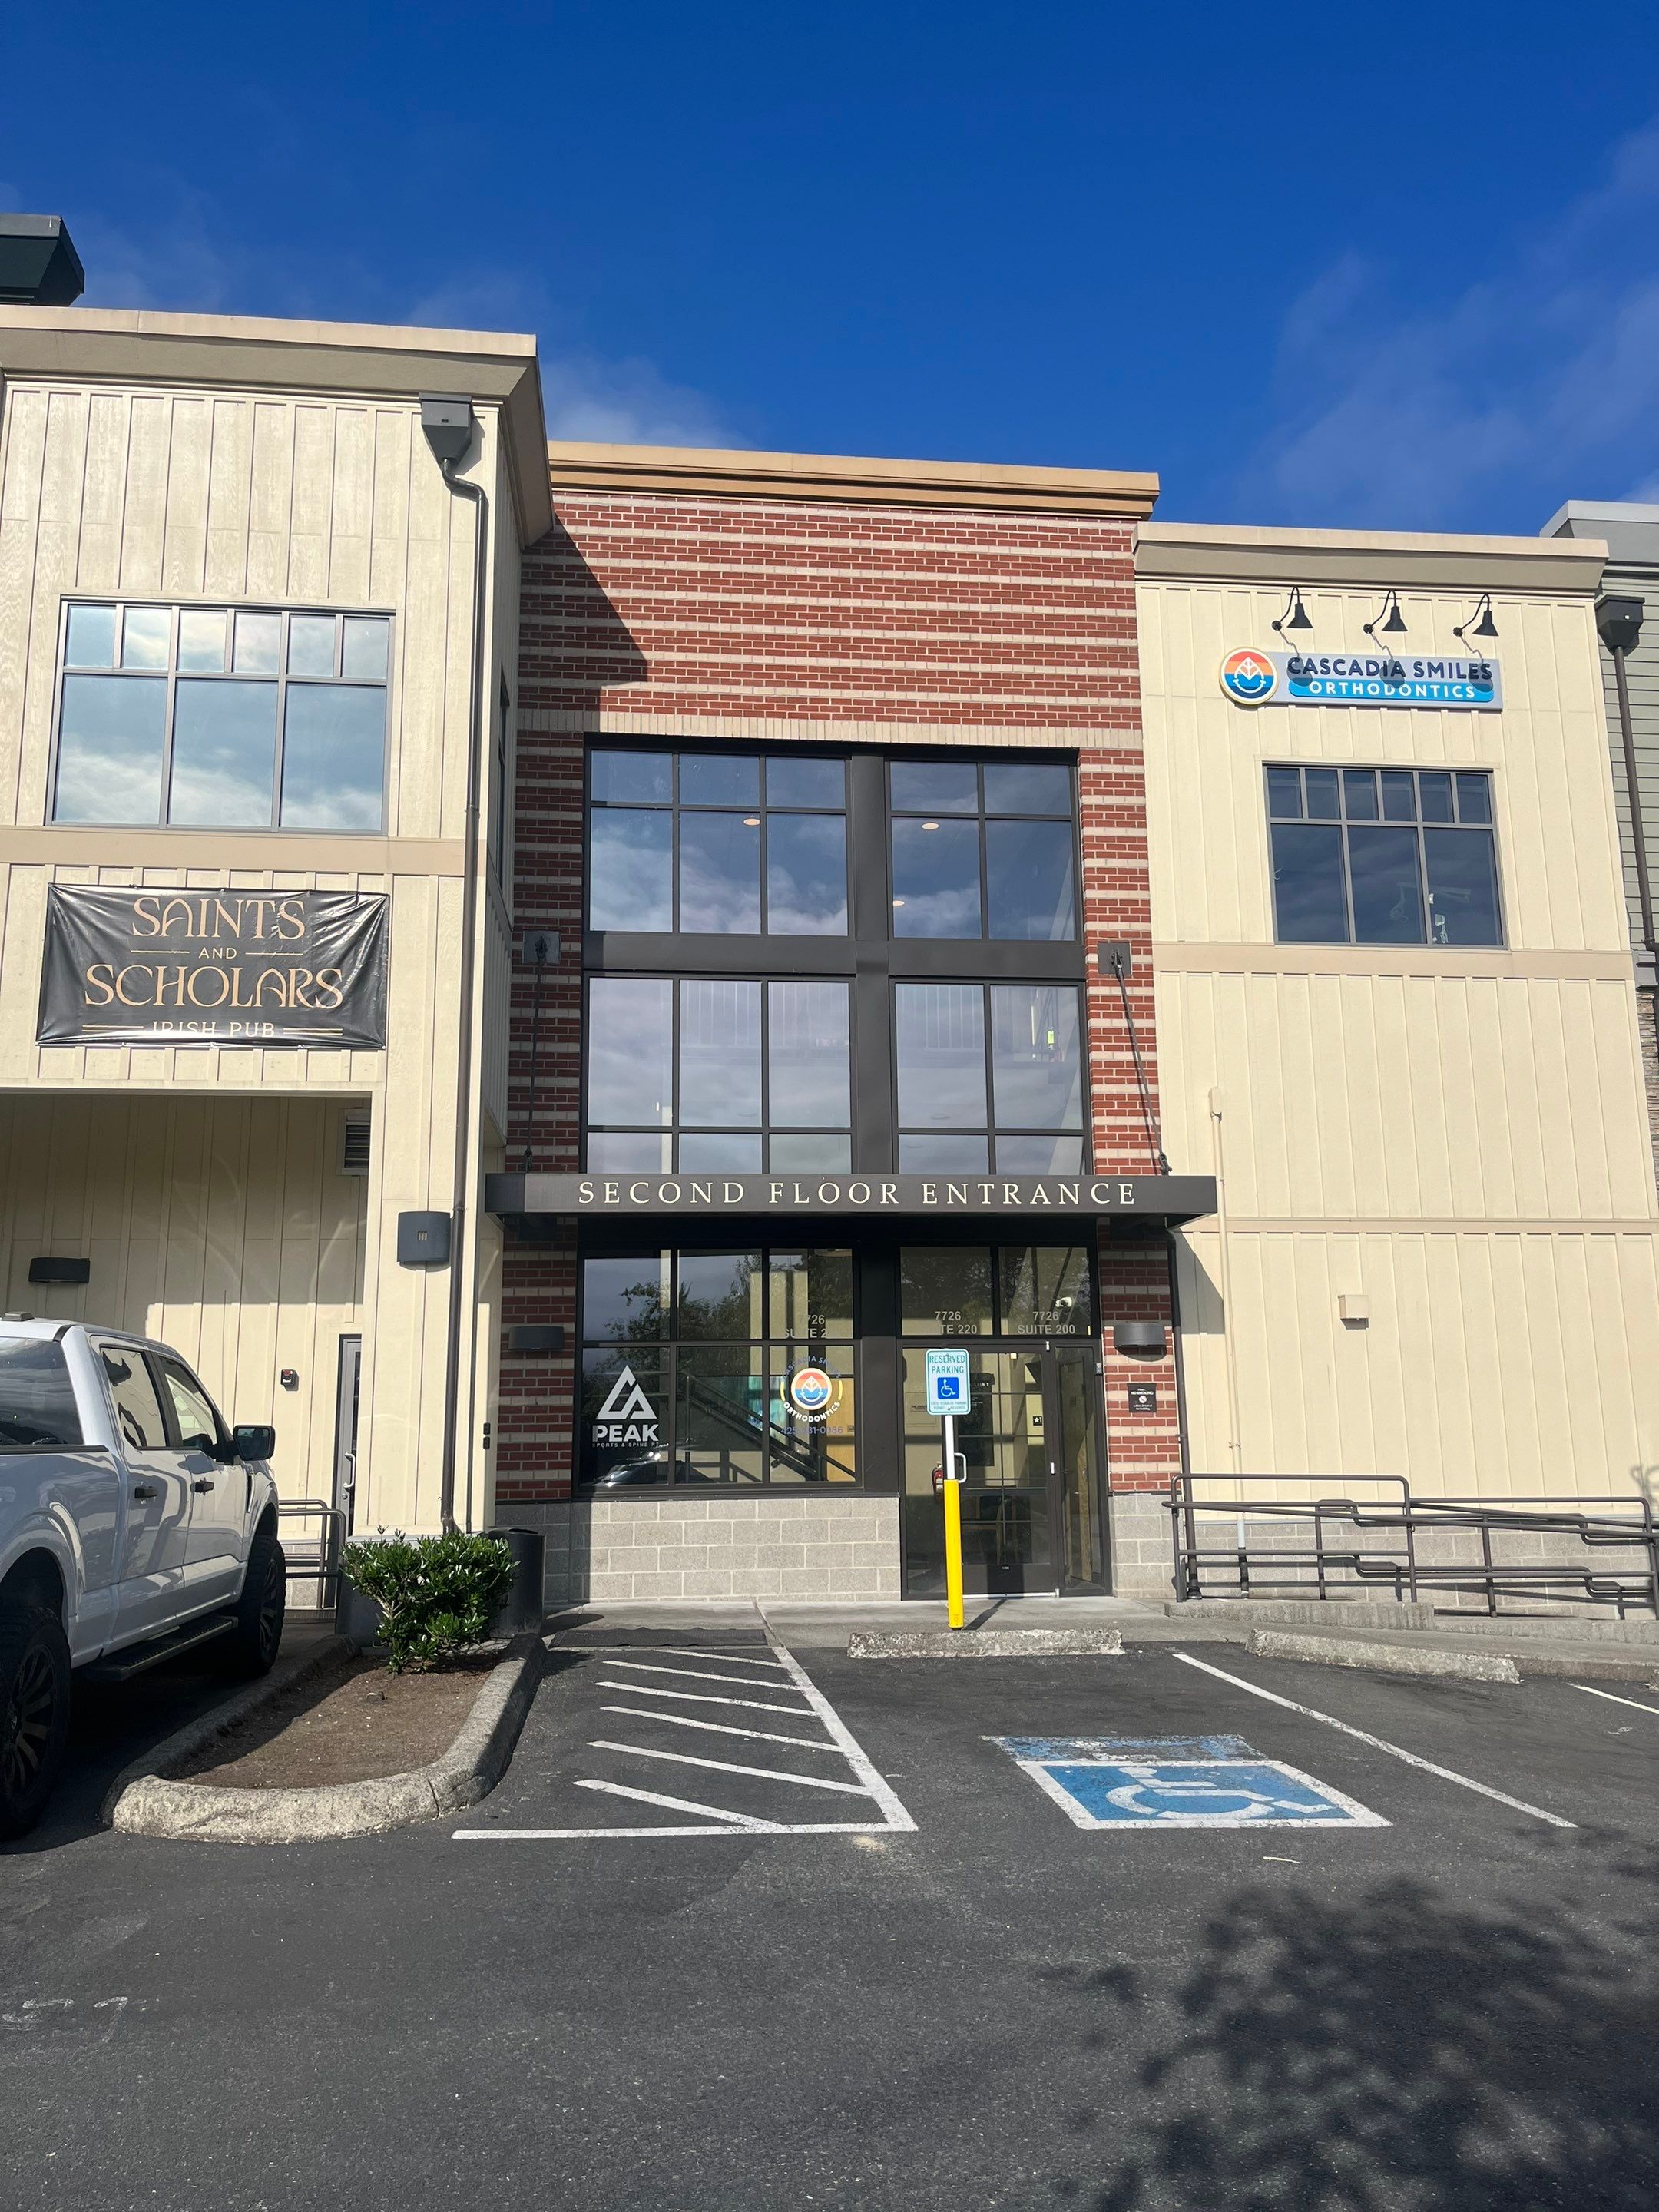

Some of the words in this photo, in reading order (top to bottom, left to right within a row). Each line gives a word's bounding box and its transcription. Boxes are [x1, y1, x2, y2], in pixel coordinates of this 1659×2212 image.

[1286, 657, 1406, 677] CASCADIA
[1413, 661, 1492, 680] SMILES
[1308, 681, 1475, 699] ORTHODONTICS
[131, 896, 306, 940] SAINTS
[198, 947, 237, 959] AND
[84, 964, 343, 1010] SCHOLARS
[152, 1021, 217, 1035] IRISH
[230, 1022, 275, 1037] PUB
[578, 1181, 745, 1205] SECOND
[769, 1181, 899, 1205] FLOOR
[922, 1182, 1136, 1205] ENTRANCE
[934, 1311, 961, 1321] 7726
[1032, 1311, 1059, 1321] 7726
[958, 1324, 978, 1335] 220
[1018, 1324, 1052, 1335] SUITE
[1057, 1324, 1075, 1335] 200
[929, 1355, 965, 1363] RESERVED
[931, 1366, 964, 1374] PARKING
[783, 1401, 840, 1422] ORTHODONTICS
[592, 1424, 659, 1442] PEAK
